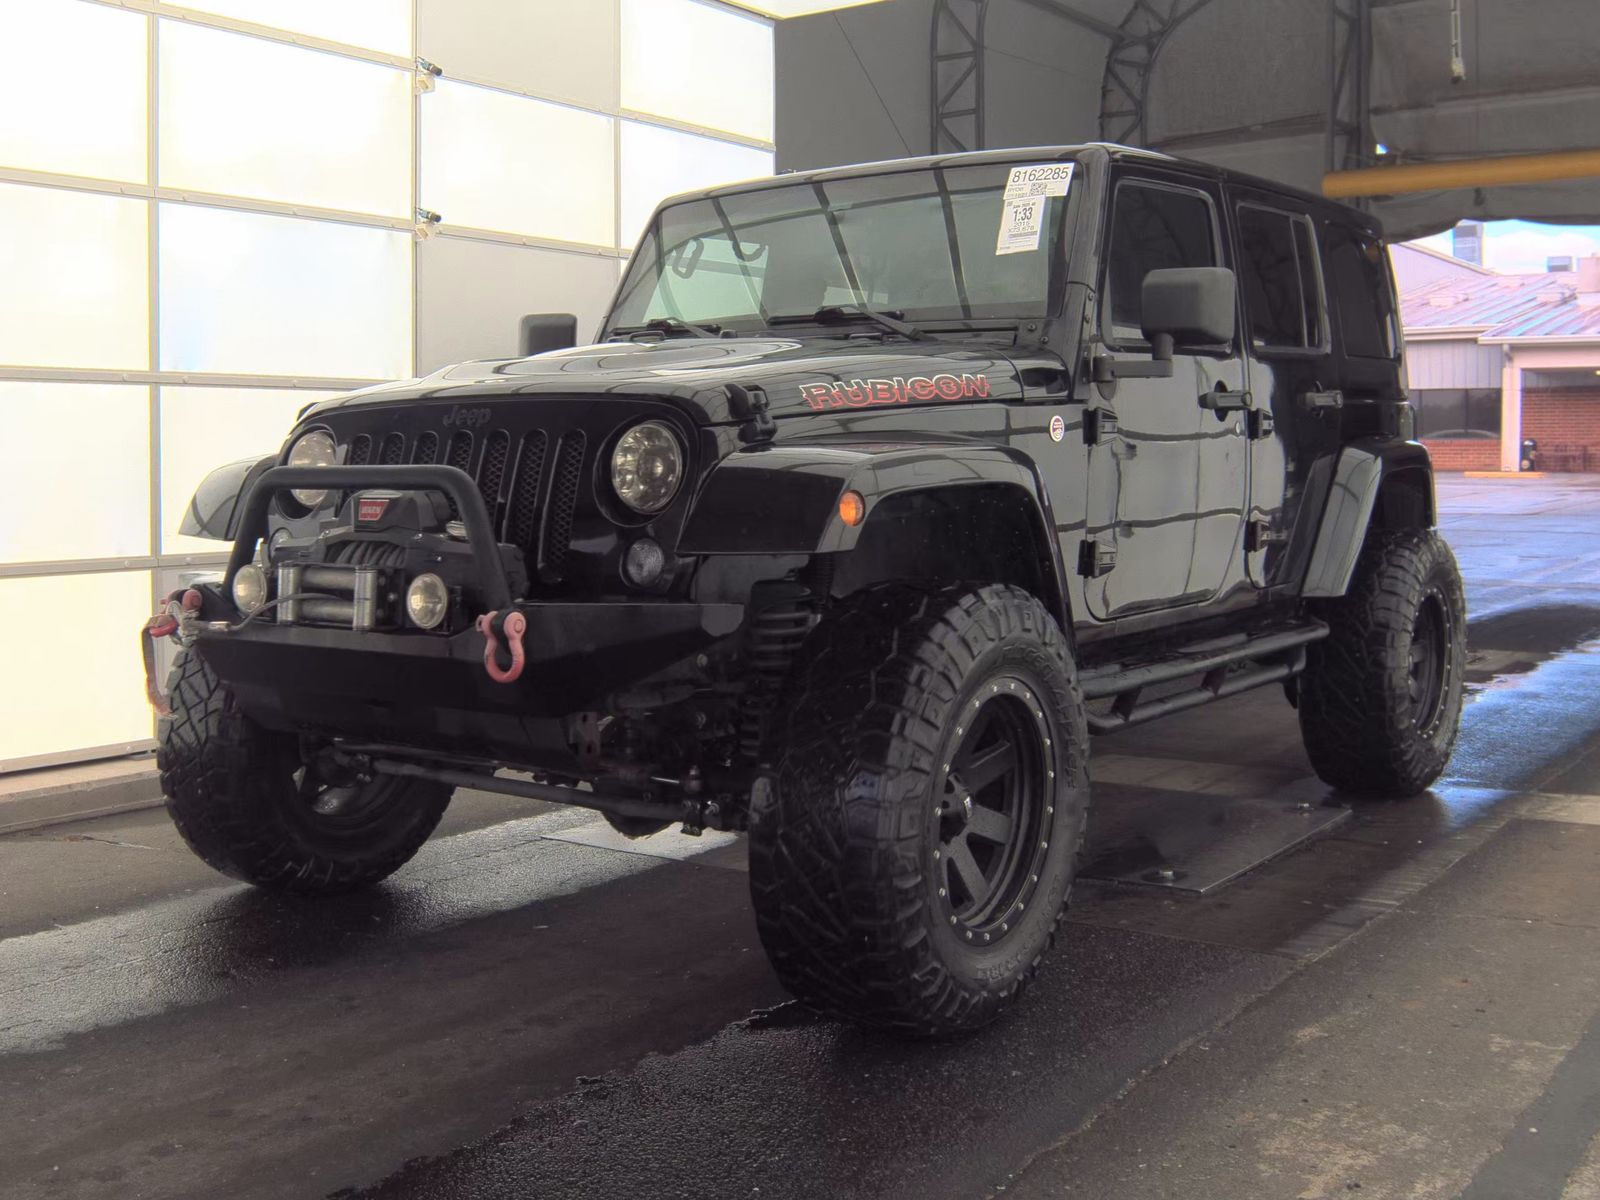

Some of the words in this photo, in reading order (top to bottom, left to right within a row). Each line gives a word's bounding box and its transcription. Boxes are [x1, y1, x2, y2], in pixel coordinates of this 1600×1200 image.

[1012, 167, 1069, 183] 8162285
[1013, 207, 1033, 222] 1:33
[800, 374, 990, 411] RUBICON
[442, 405, 492, 427] Jeep
